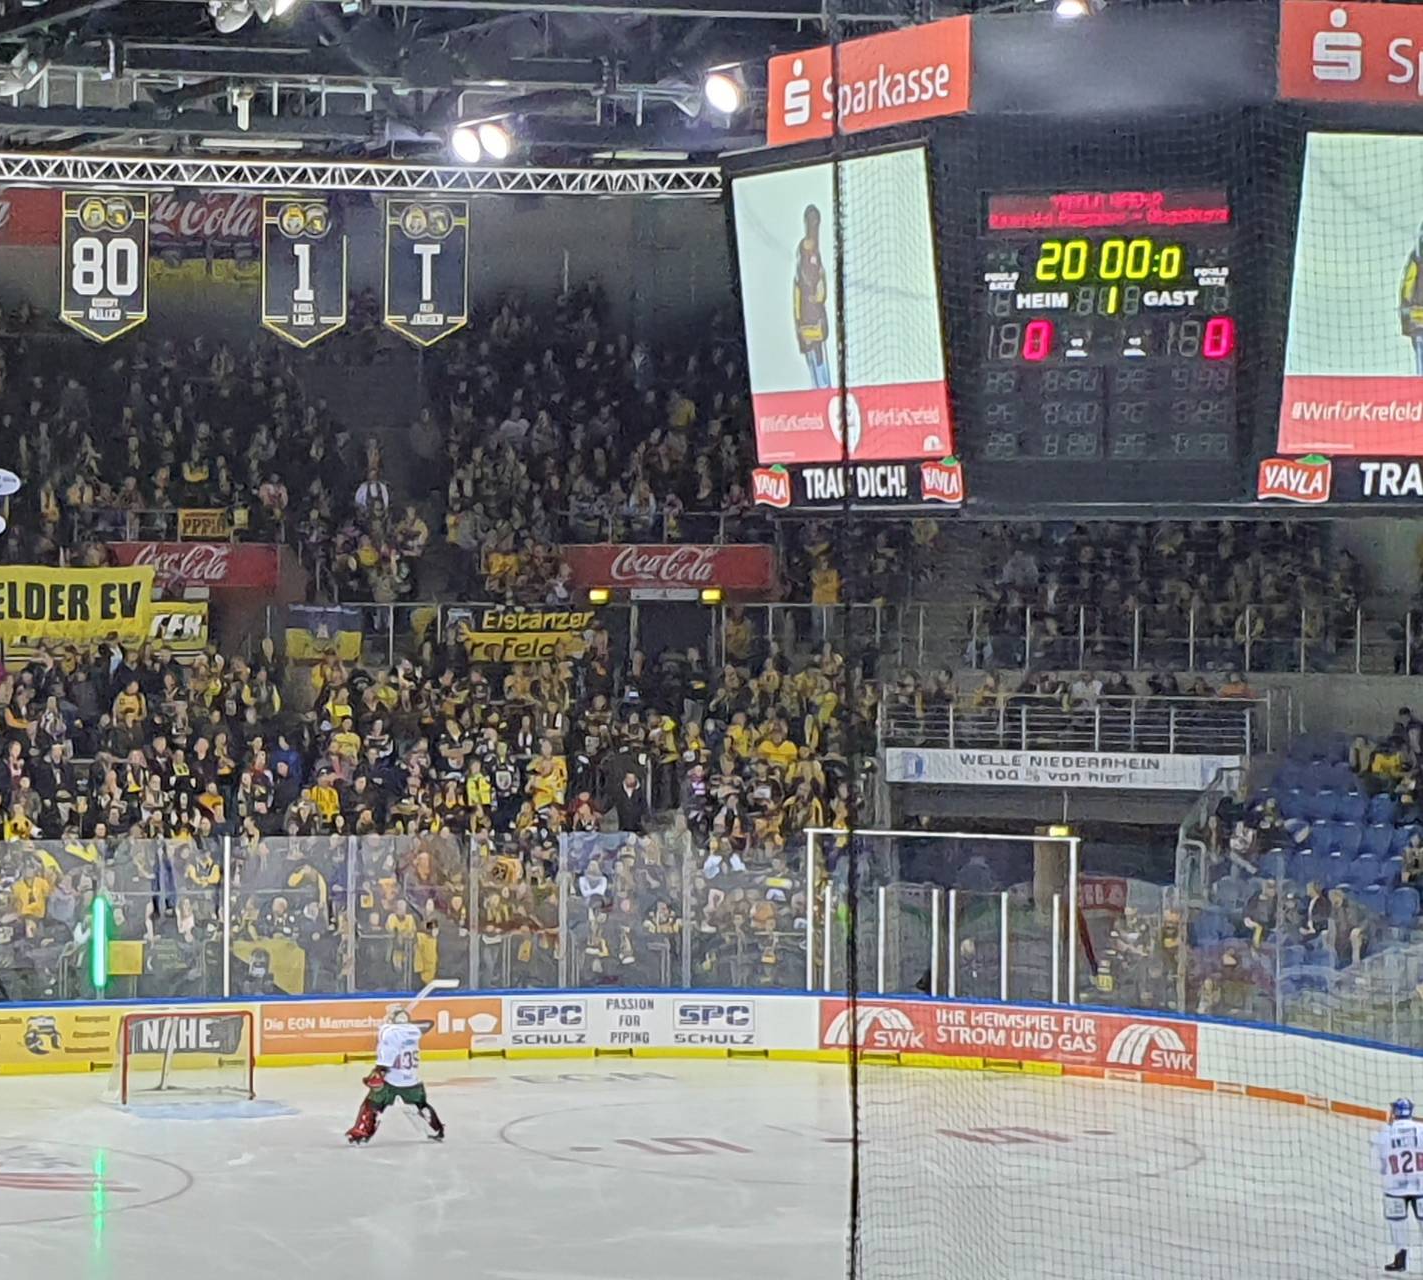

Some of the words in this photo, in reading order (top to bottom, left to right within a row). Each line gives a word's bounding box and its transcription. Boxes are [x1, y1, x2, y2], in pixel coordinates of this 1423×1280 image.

[822, 63, 950, 120] Sparkasse
[72, 237, 138, 296] 80
[1036, 240, 1088, 280] 20
[293, 244, 314, 301] 1
[413, 244, 441, 300] T
[1017, 292, 1069, 309] HEIM
[1143, 290, 1199, 307] GAST
[1022, 319, 1054, 361] 0
[1203, 316, 1234, 358] 0
[857, 465, 908, 498] DICH!
[1265, 466, 1323, 494] YAYLA
[101, 581, 142, 620] EV
[470, 637, 561, 662] rfeld
[960, 754, 1021, 767] WELLE
[1029, 756, 1160, 770] NIEDERRHEIN
[986, 770, 1018, 782] 100
[1049, 773, 1081, 783] von
[516, 1004, 582, 1027] SPC
[606, 998, 654, 1010] PASSION
[679, 1004, 750, 1027] SPC
[263, 1017, 284, 1031] Die
[288, 1016, 315, 1031] EGN
[619, 1014, 641, 1027] FOR
[936, 1009, 967, 1025] IHR
[971, 1011, 1059, 1032] HEIMSPIEL
[512, 1033, 586, 1045] SCHULZ
[610, 1032, 650, 1045] PIPING
[675, 1033, 754, 1045] SCHULZ
[874, 1031, 924, 1048] SWK
[937, 1026, 1005, 1046] STROM
[1011, 1031, 1054, 1049] UND
[1058, 1034, 1097, 1053] GAS
[1150, 1050, 1193, 1071] SWK
